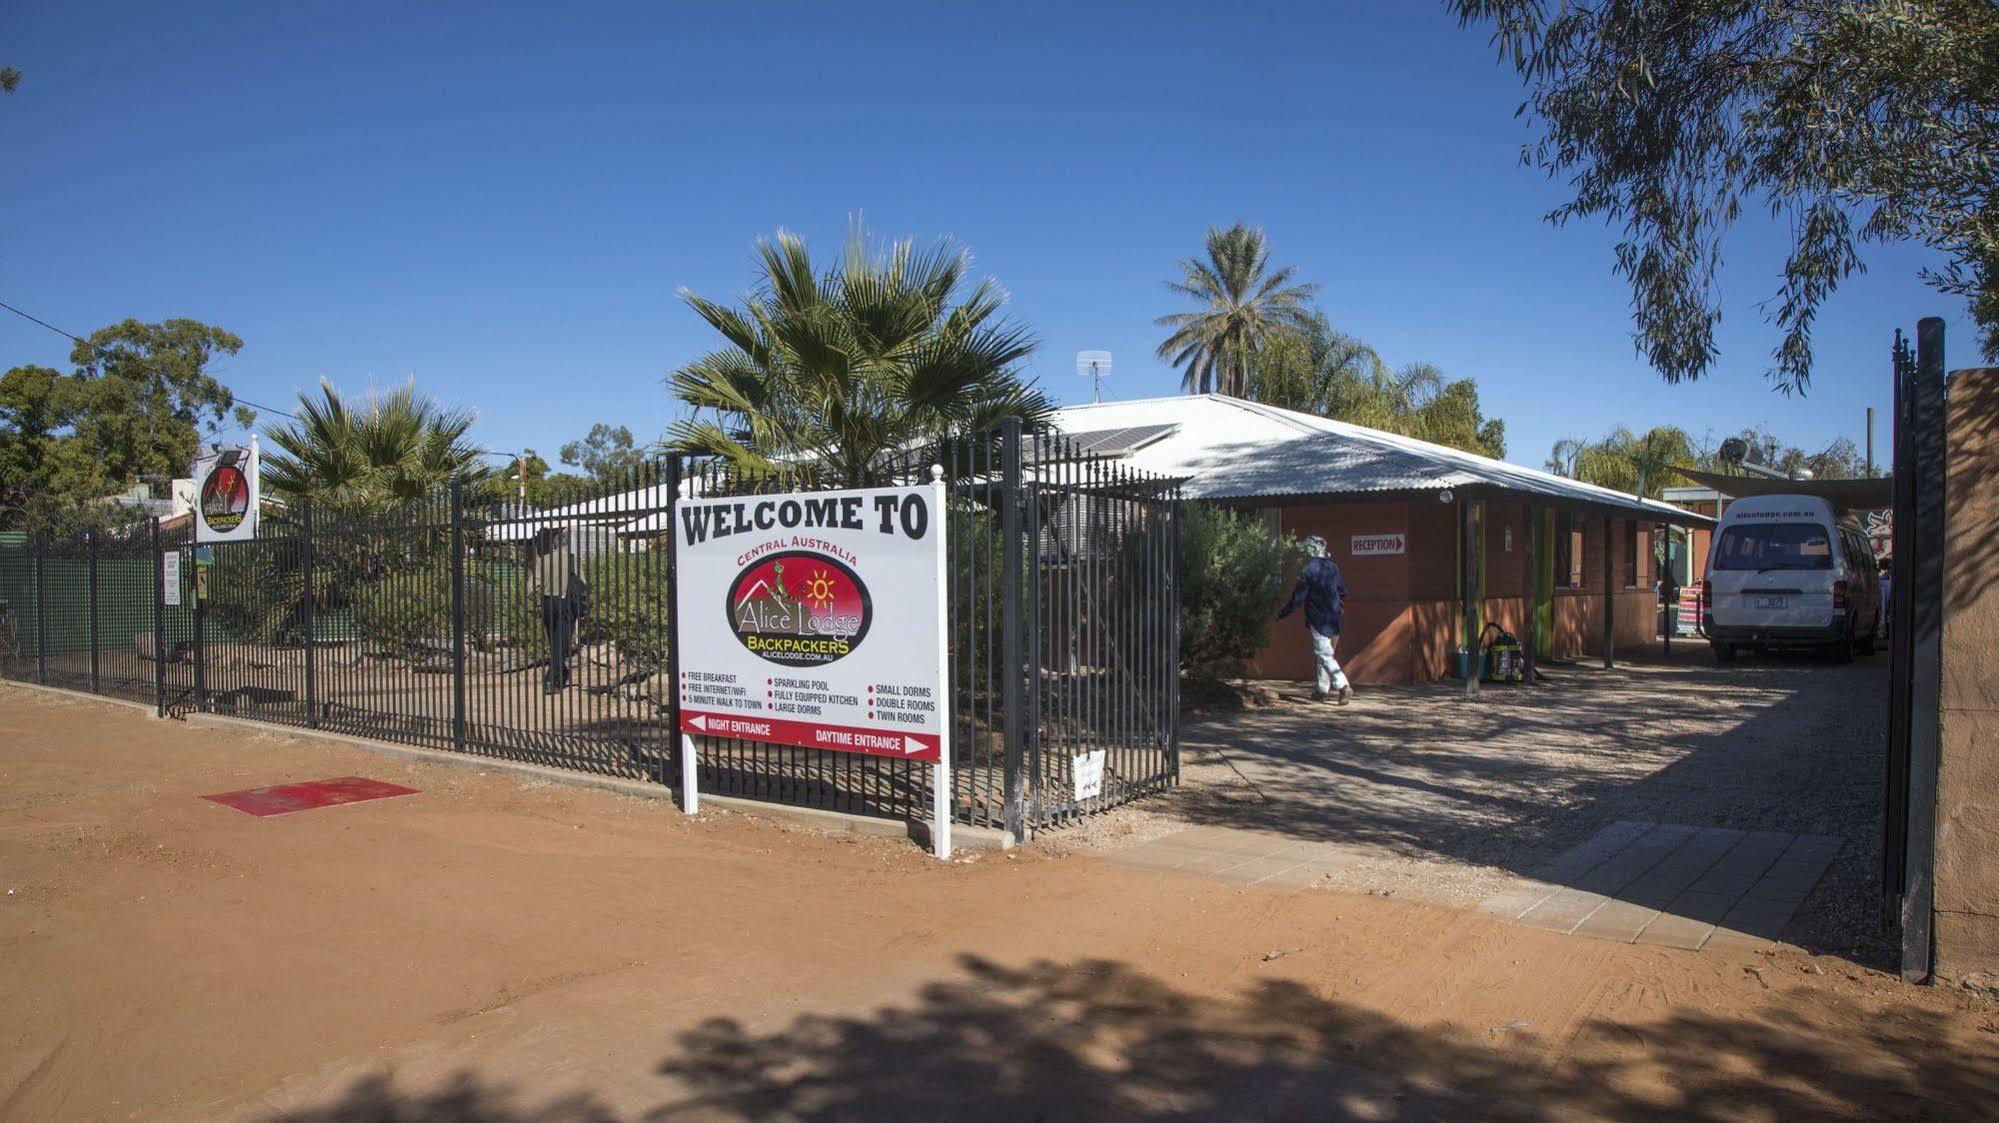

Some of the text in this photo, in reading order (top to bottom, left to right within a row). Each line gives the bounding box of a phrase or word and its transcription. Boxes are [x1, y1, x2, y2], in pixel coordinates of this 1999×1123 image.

[207, 514, 242, 525] BACKPACKERS
[682, 493, 928, 546] WELCOME TO
[737, 536, 856, 567] CENTRAL AUSTRALIA
[1353, 538, 1395, 551] RECEPTION
[738, 602, 860, 640] Alice Lodge
[747, 636, 849, 654] BACKPACKERS
[762, 651, 834, 661] ALICELODGE.COM.AU
[688, 672, 736, 683] FREE BREAKFAST
[774, 678, 829, 691] SPARKLING POOL
[688, 683, 702, 693] FREE
[876, 684, 931, 697] SMALL DORMS
[688, 695, 762, 710] 5 MINUTE WALK TO TOWN
[774, 690, 858, 706] FULLY EQUIPPED KITCHEN
[876, 697, 935, 712] DOUBLE ROOMS
[774, 703, 822, 716] LARGE DORMS
[877, 710, 925, 724] TWIN ROOMS
[708, 718, 770, 736] NIGHT ENTRANCE
[816, 729, 901, 751] DAYTIME ENTRANCE
